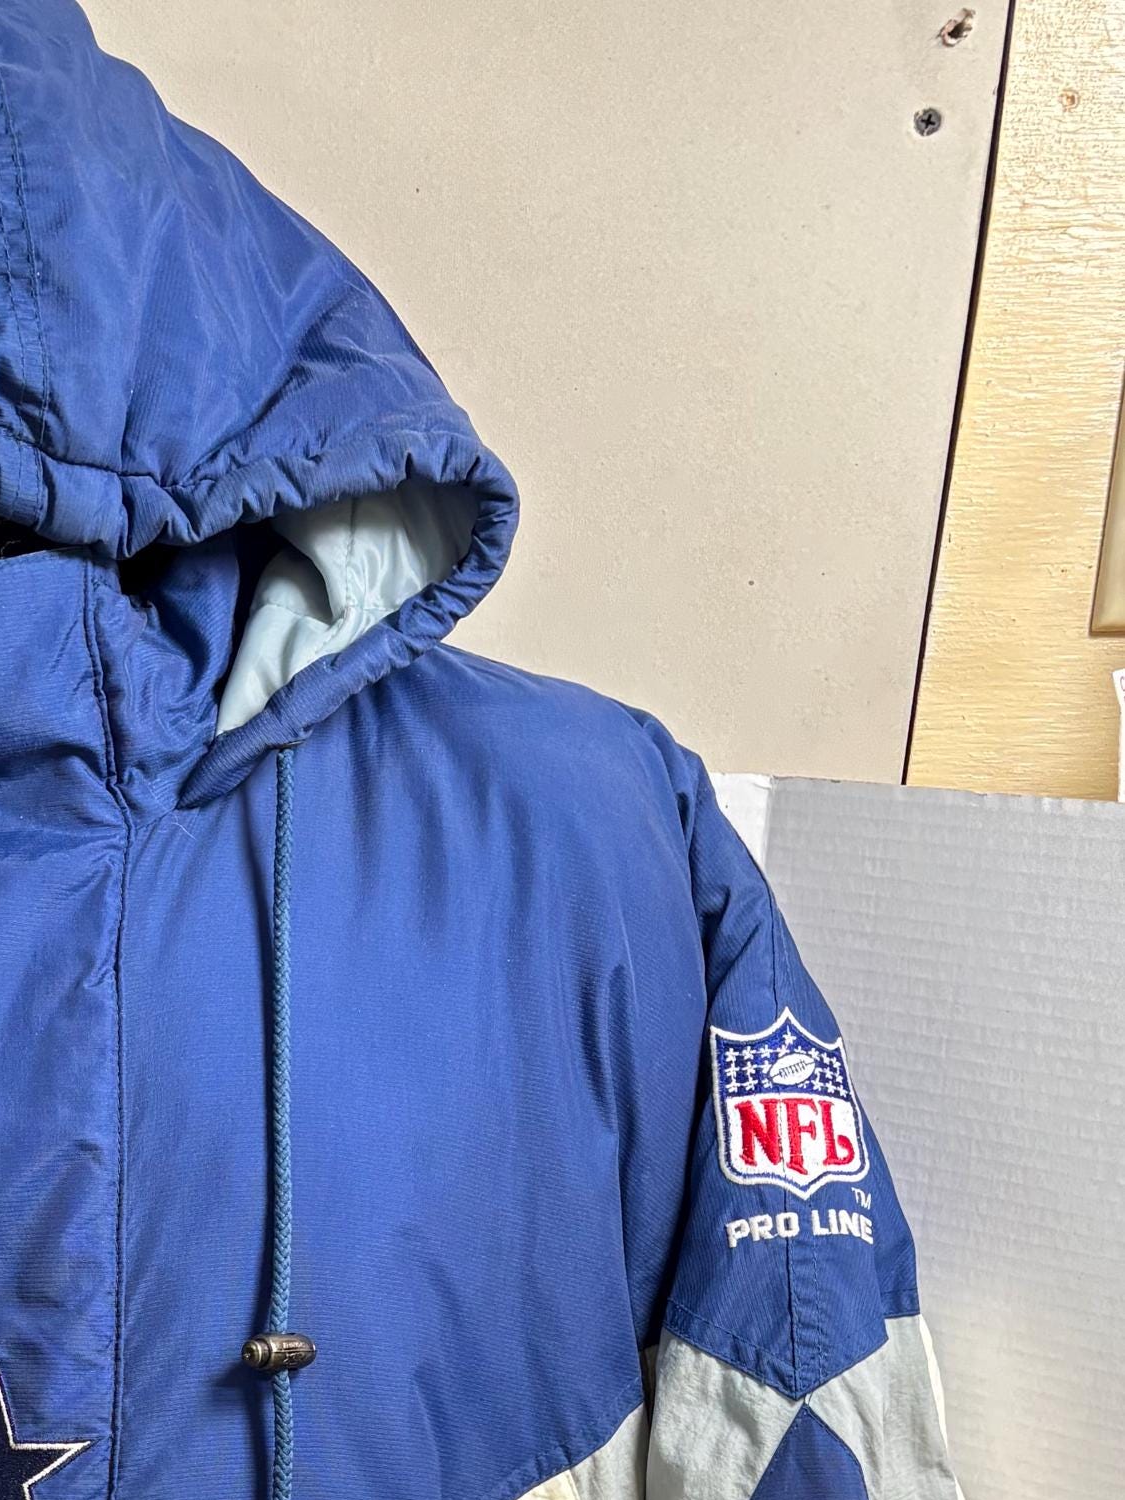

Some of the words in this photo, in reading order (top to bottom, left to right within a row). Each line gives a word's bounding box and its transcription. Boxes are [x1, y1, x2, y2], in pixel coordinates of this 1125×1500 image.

[734, 1097, 856, 1175] NFL
[851, 1187, 872, 1210] TM
[725, 1211, 800, 1248] PRO
[810, 1208, 874, 1245] LINE
